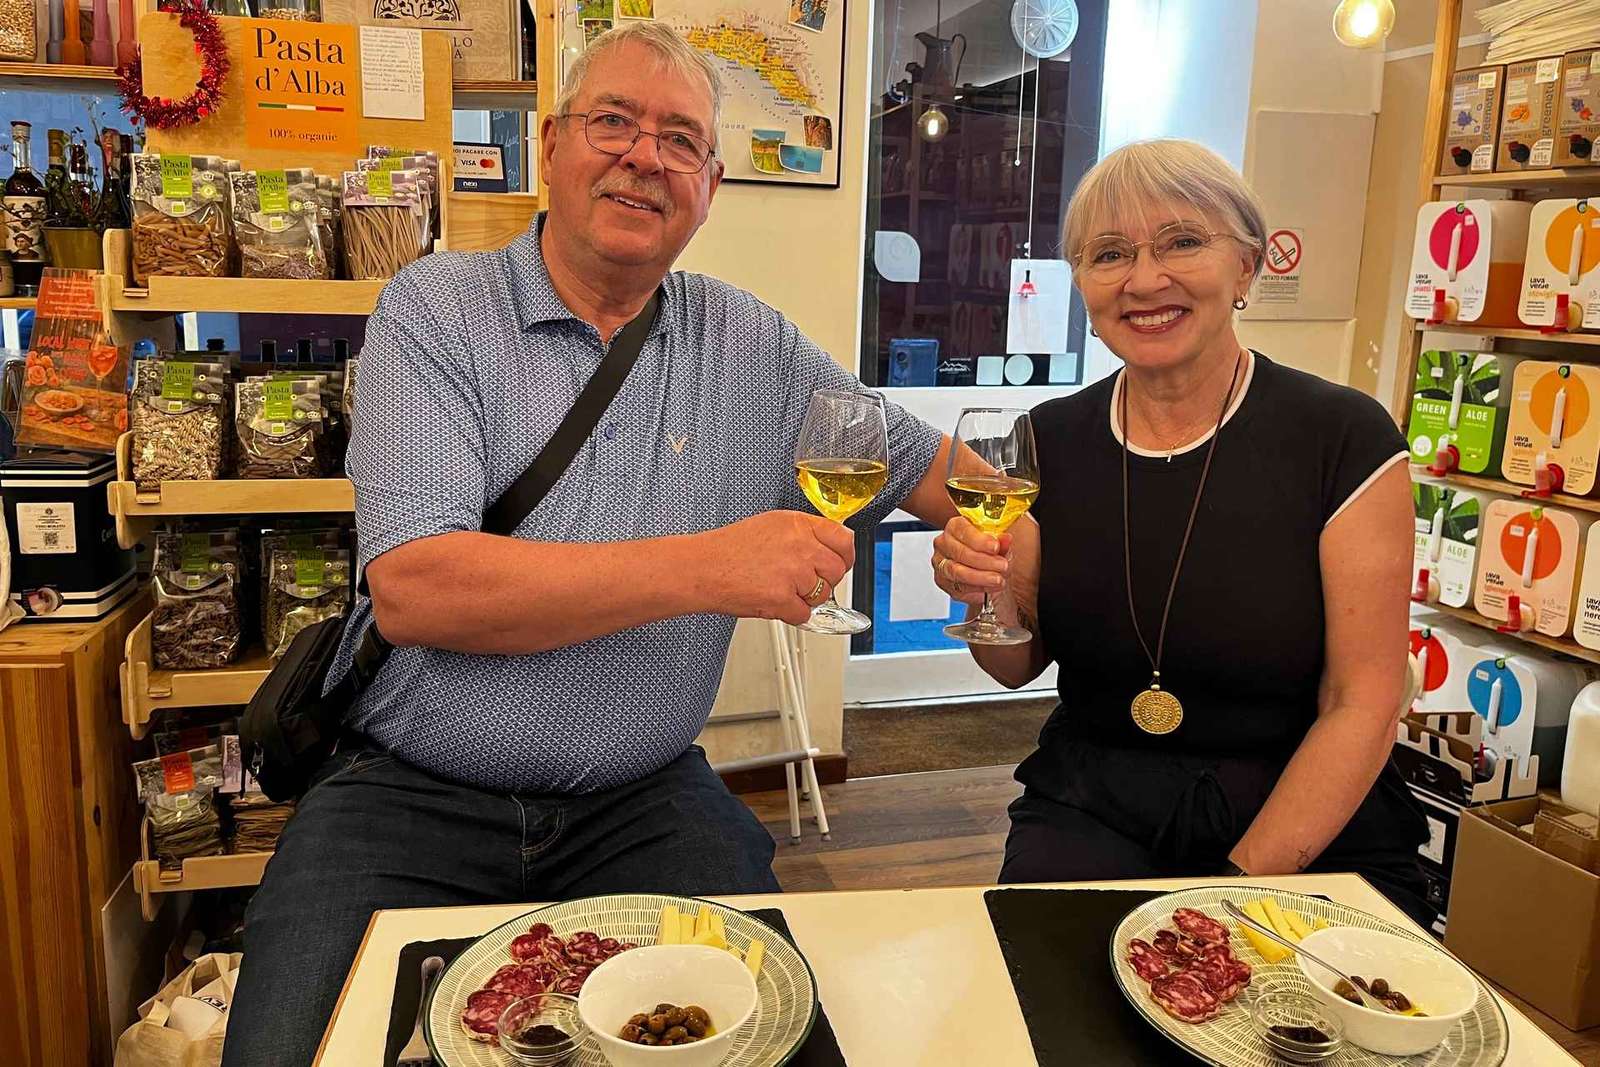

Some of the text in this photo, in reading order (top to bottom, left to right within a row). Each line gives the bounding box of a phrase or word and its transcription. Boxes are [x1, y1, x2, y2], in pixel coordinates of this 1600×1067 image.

[254, 27, 346, 64] Pasta
[255, 67, 346, 97] d'Alba
[269, 128, 338, 143] 100% organic
[163, 159, 189, 169] Pasta
[260, 175, 284, 184] Pasta
[167, 365, 191, 375] Pasta
[1416, 402, 1488, 421] GREEN ALOE
[1447, 545, 1468, 558] ALOE
[1485, 572, 1501, 580] lava
